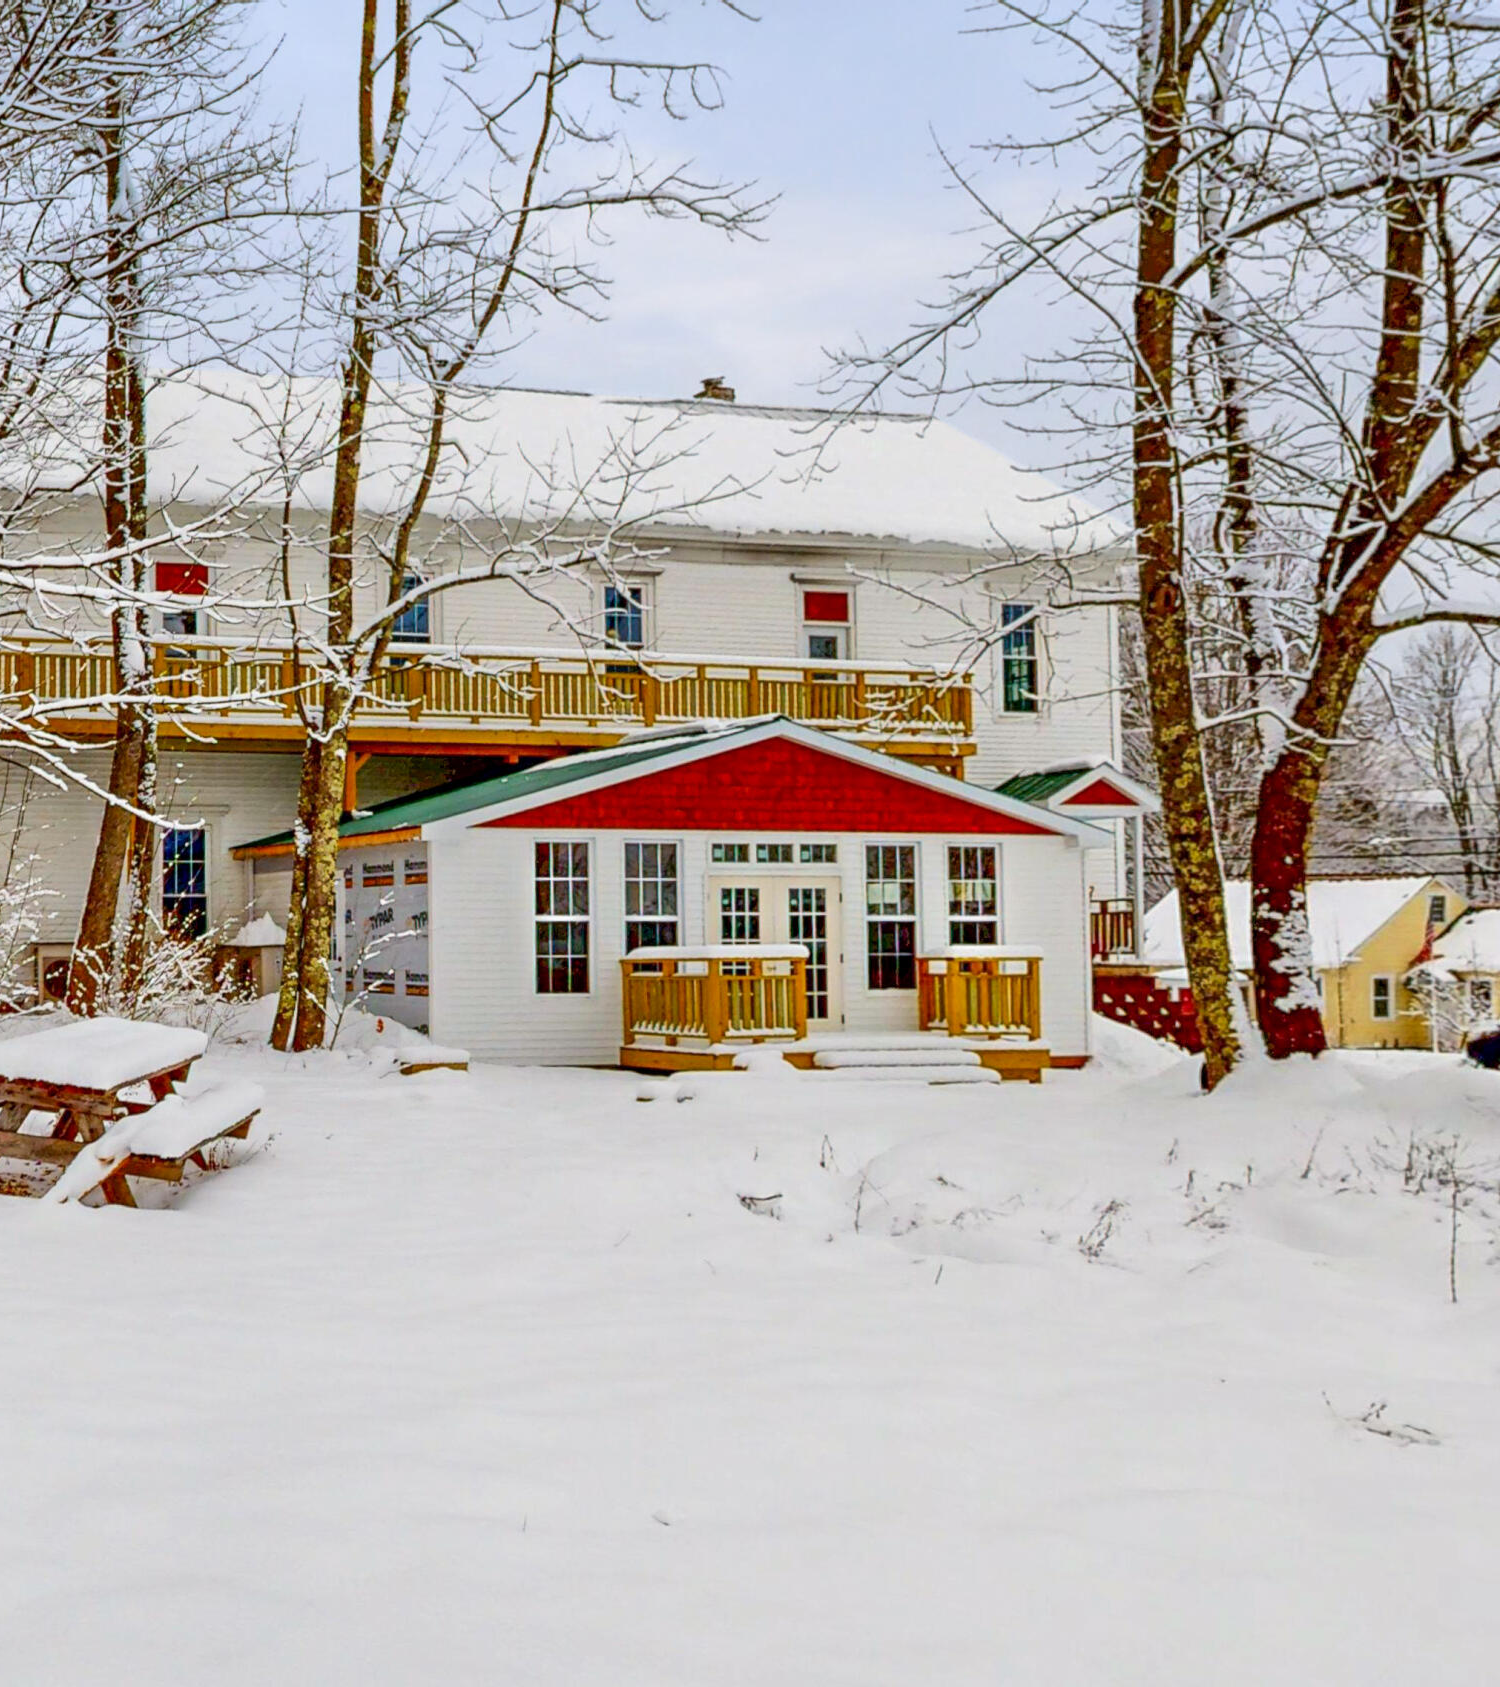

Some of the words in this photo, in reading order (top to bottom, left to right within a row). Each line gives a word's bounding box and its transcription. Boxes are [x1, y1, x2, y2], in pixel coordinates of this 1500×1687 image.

[362, 860, 394, 874] Hammond
[368, 906, 394, 931] TYPAR
[411, 911, 428, 930] TYP
